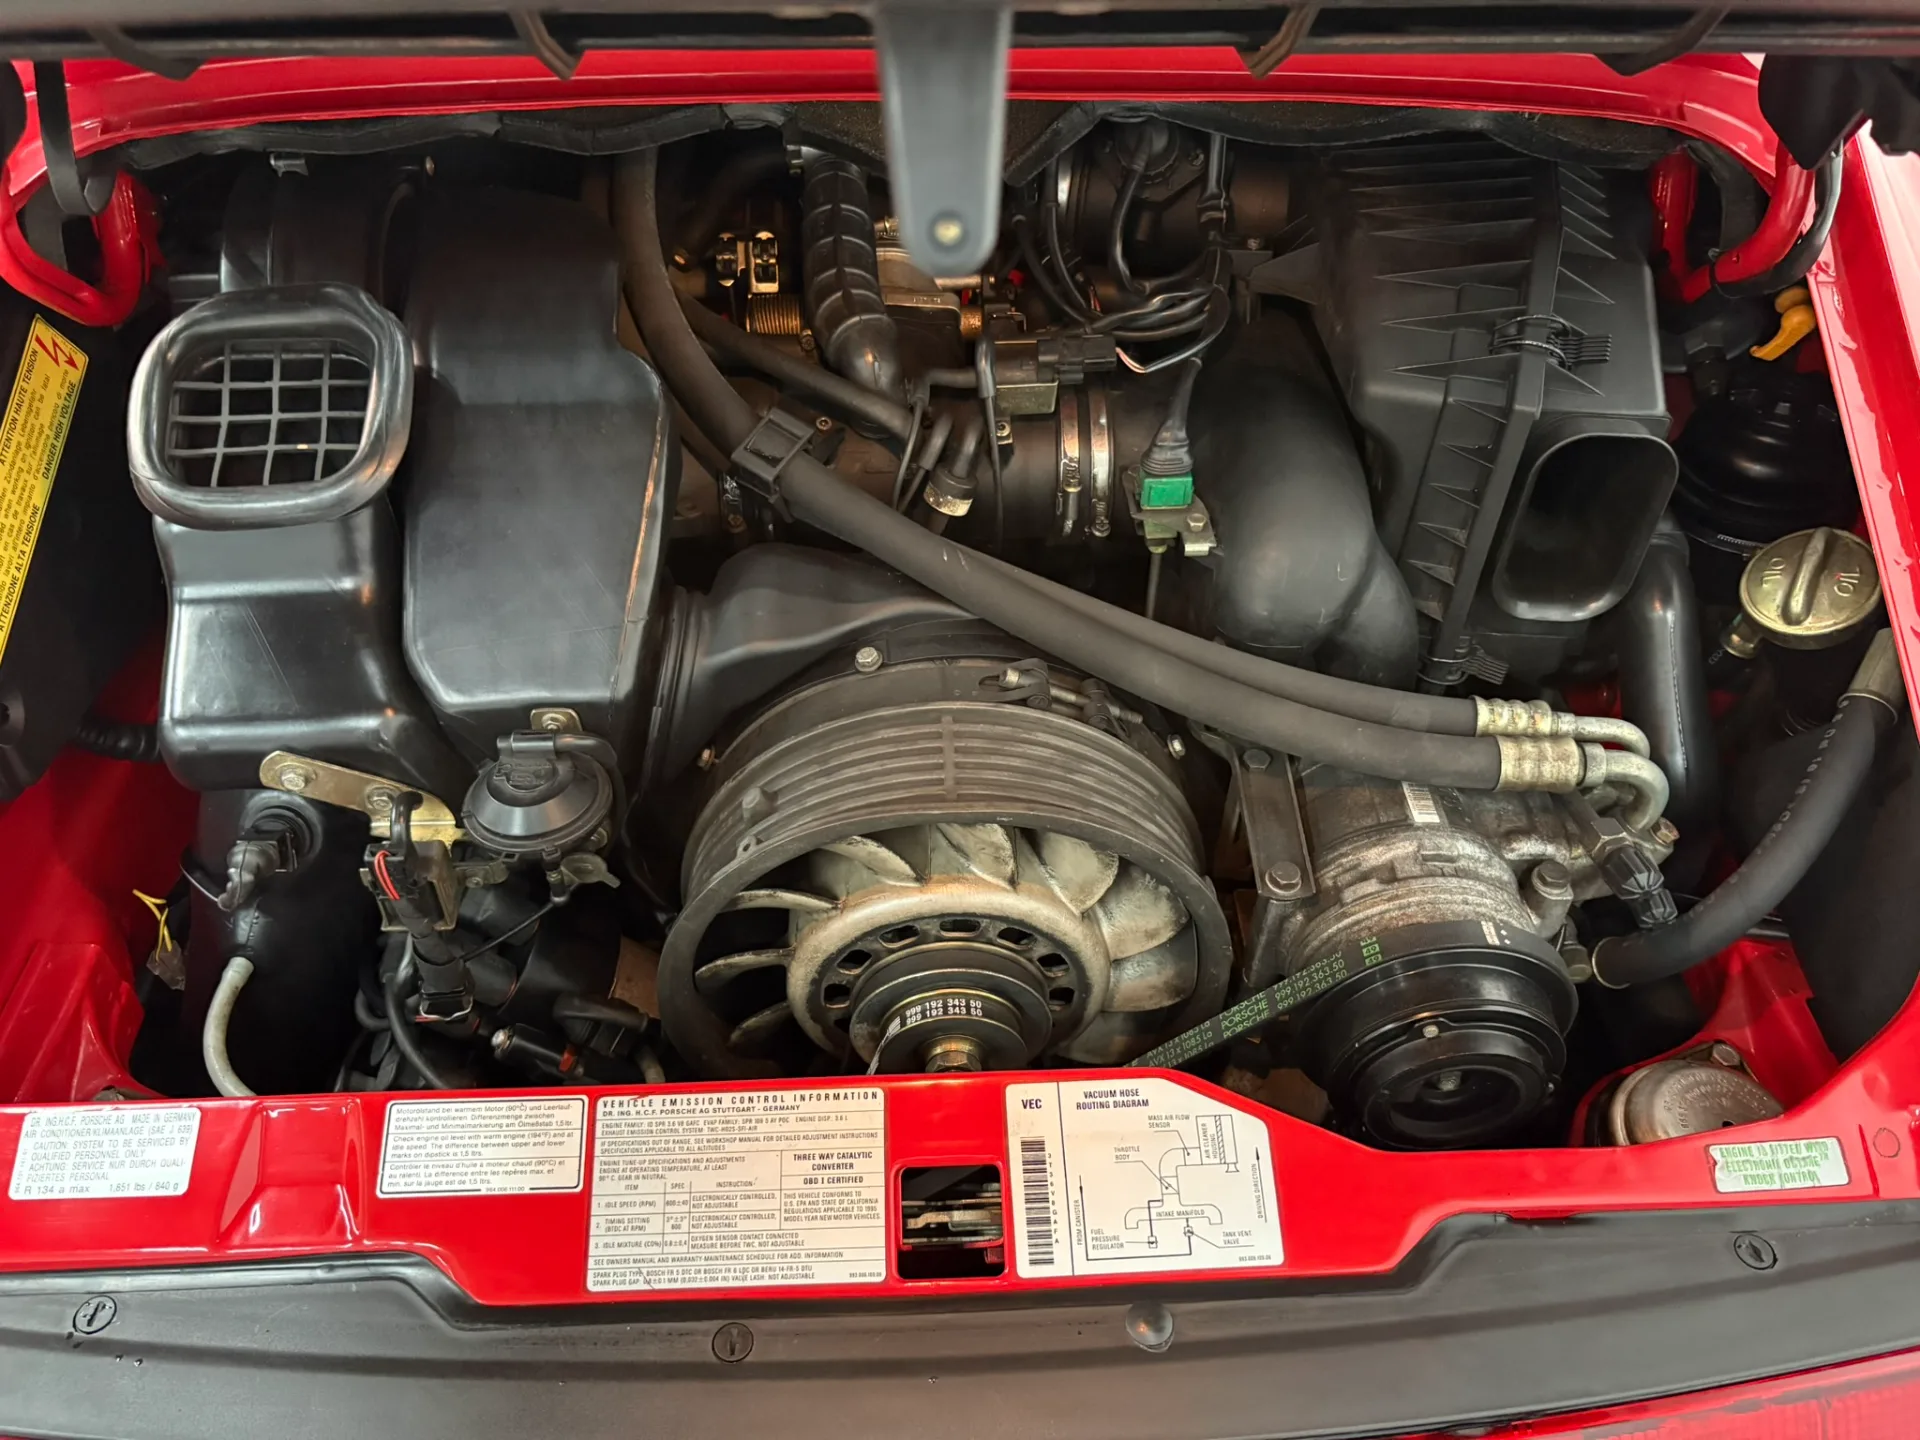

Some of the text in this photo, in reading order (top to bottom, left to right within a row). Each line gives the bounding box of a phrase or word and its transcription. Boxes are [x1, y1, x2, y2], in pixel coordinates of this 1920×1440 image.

[0, 348, 38, 465] ATTENTION HAUTE TENSION
[11, 466, 24, 495] working
[25, 423, 36, 450] ignition
[38, 392, 45, 404] be
[42, 374, 50, 392] fatal
[42, 380, 76, 479] DANGER HIGH VOLTAGE
[6, 524, 14, 538] cas
[12, 509, 19, 520] de
[16, 479, 28, 507] travaux
[0, 504, 40, 632] ATTENZIONE ALTA TENSIONE
[1762, 558, 1786, 588] OIL
[1834, 567, 1860, 597] OIL
[1221, 999, 1268, 1029] PORSCHE
[1275, 959, 1344, 1000] 999.192.363.50
[906, 1005, 921, 1017] 999
[925, 1000, 942, 1009] 192
[906, 1013, 922, 1025] 999
[926, 1009, 943, 1018] 192
[603, 1091, 878, 1108] VEHICLE EMISSION CONTROL INFORMATION
[1084, 1088, 1140, 1099] VACUUM HOSE
[1021, 1099, 1042, 1109] VEC
[1076, 1099, 1149, 1110] ROUTING DIAGRAM
[24, 1130, 36, 1138] AIR
[1201, 1123, 1209, 1147] CLEANER
[73, 1140, 104, 1149] SYSTEM
[109, 1139, 118, 1148] TO
[123, 1139, 132, 1147] BE
[137, 1138, 175, 1147] SERVICED
[180, 1137, 190, 1145] BY
[31, 1149, 146, 1161] QUALIFIED PERSONNEL ONLY
[72, 1161, 104, 1170] SERVICE
[109, 1160, 126, 1169] NUR
[129, 1159, 156, 1168] DURCH
[812, 1162, 854, 1170] CONVERTER
[69, 1172, 108, 1181] PERSONAL
[1252, 1164, 1260, 1193] DIRECTION
[24, 1186, 31, 1194] R
[38, 1186, 54, 1194] 134
[134, 1183, 145, 1191] lbs
[173, 1183, 178, 1192] g
